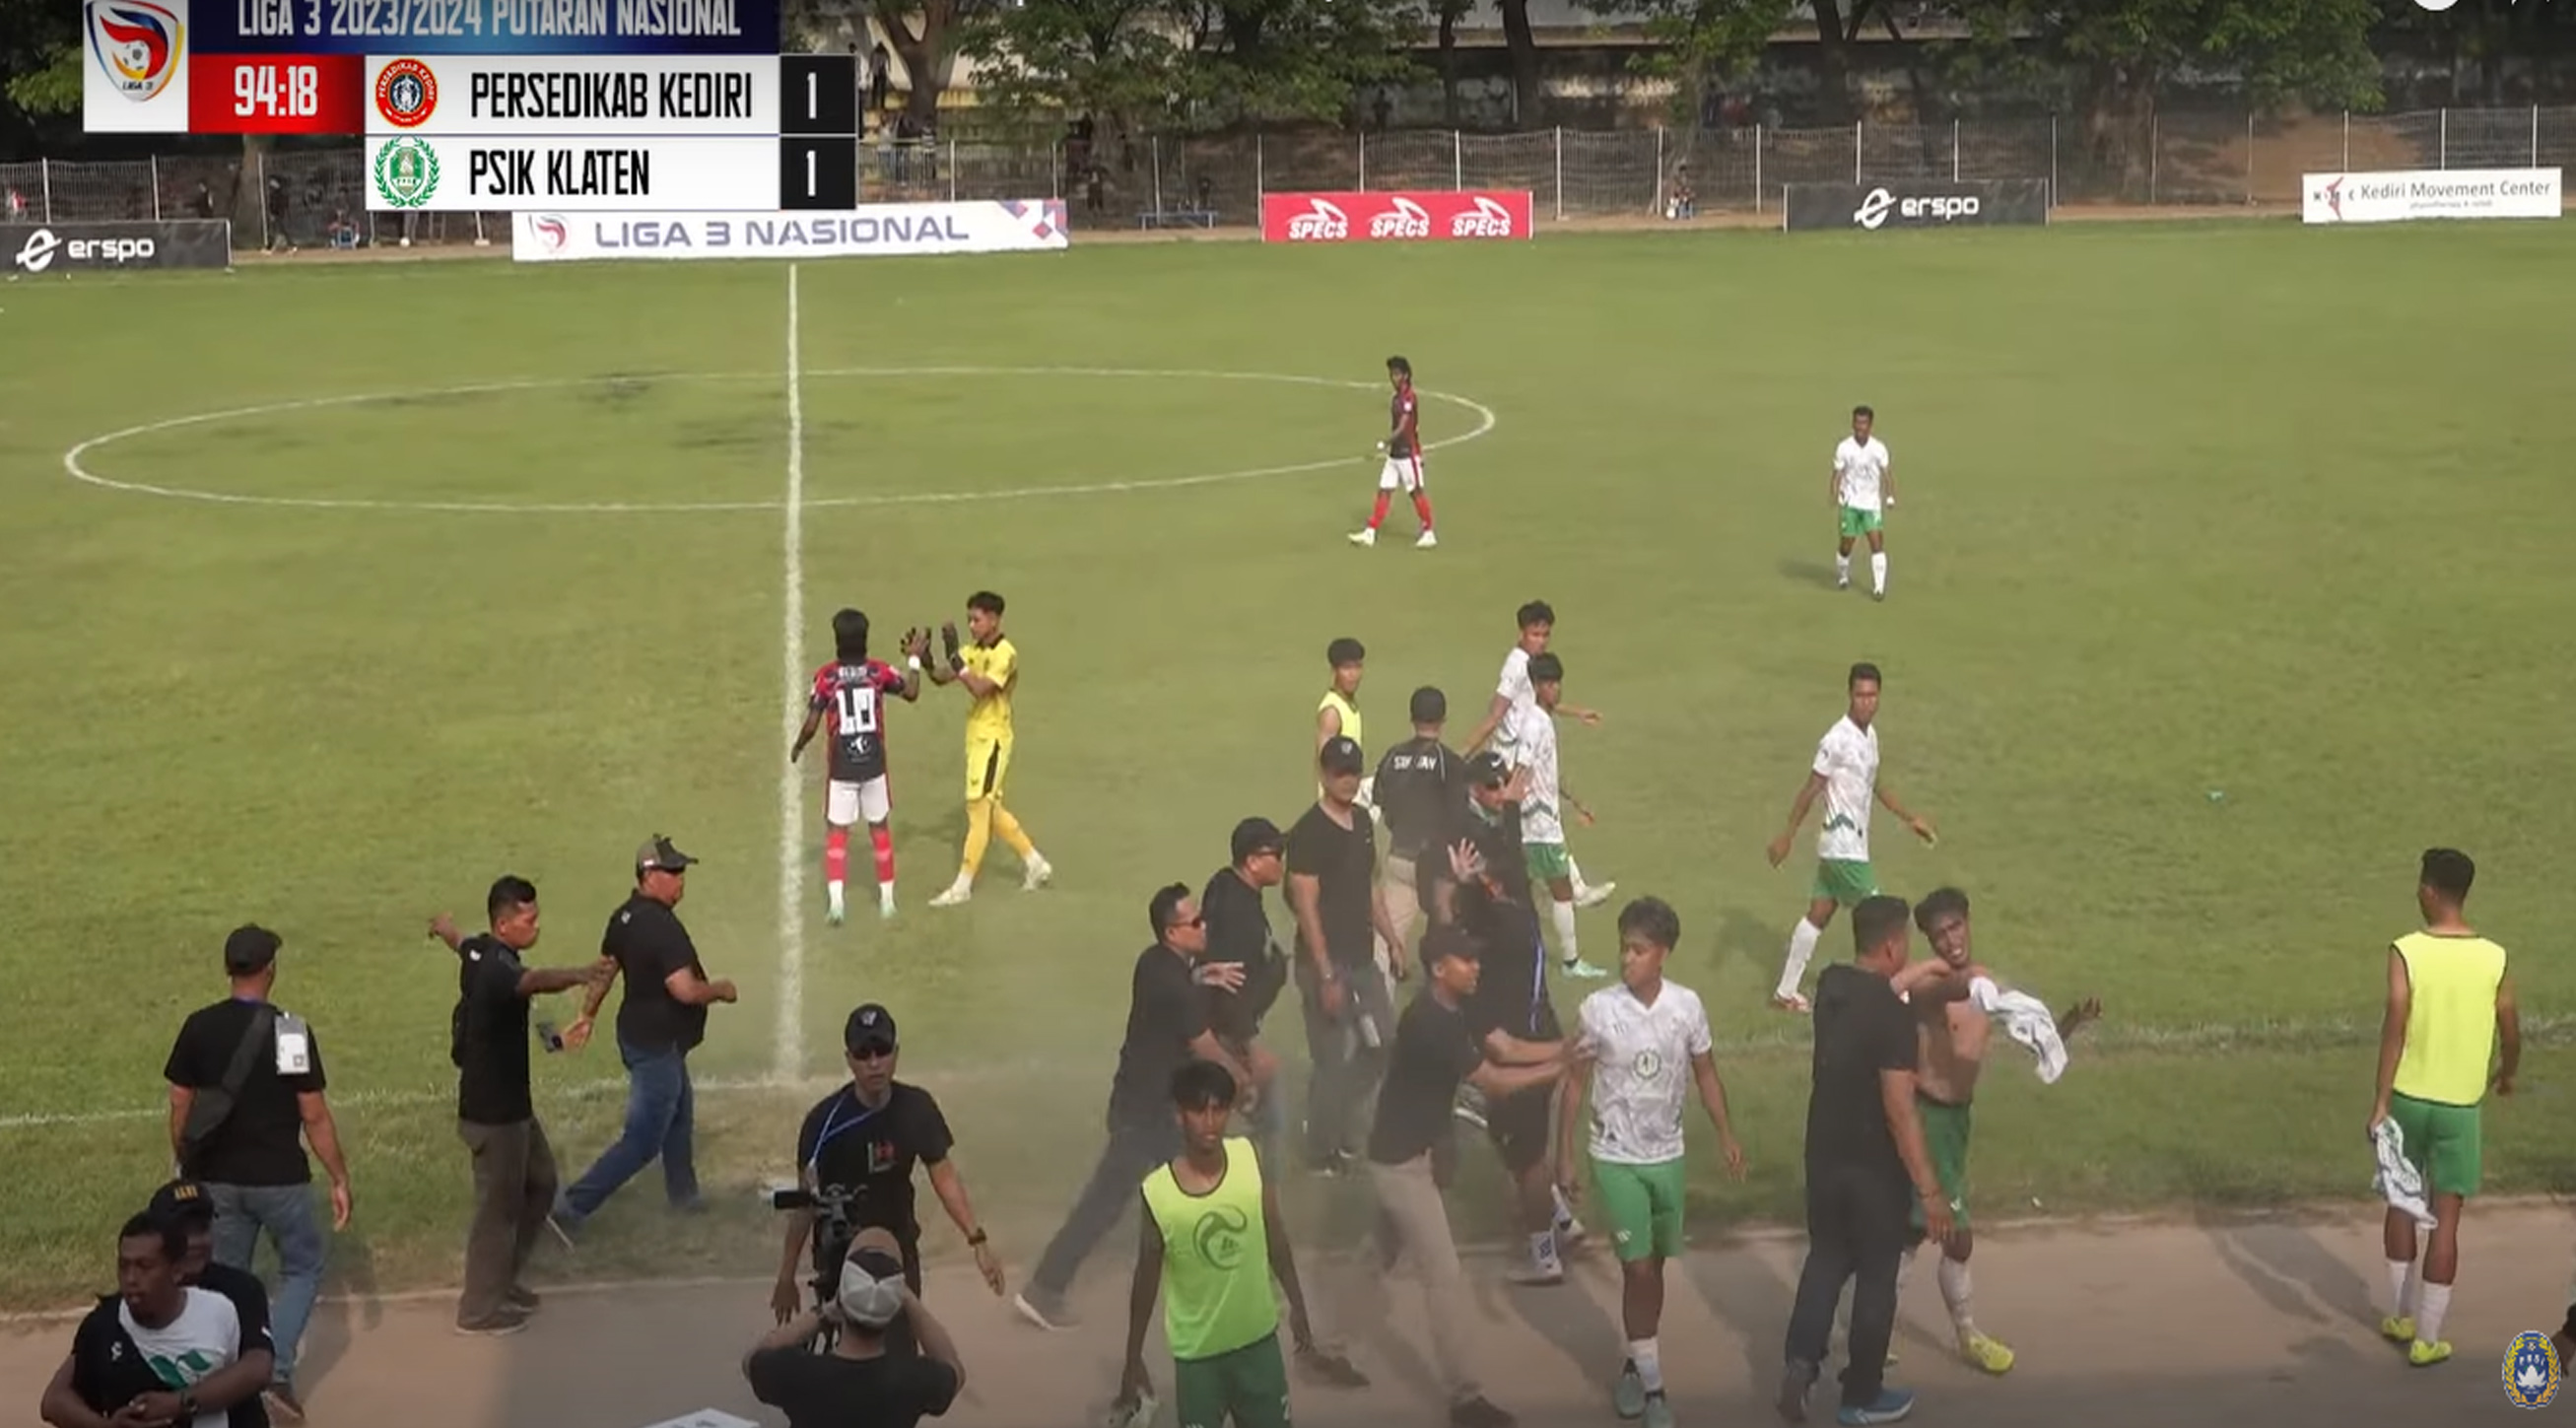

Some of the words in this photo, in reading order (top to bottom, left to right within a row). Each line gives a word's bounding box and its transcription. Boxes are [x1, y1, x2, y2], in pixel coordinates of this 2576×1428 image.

[2361, 182, 2406, 200] Kediri
[2410, 181, 2494, 198] Movement
[2499, 179, 2550, 196] Center
[1901, 196, 1980, 221] erspo
[594, 222, 692, 248] LIGA
[707, 221, 731, 246] 3
[745, 215, 971, 246] NASIONAL
[1289, 221, 1348, 239] SPECS
[1370, 220, 1429, 238] SPECS
[1452, 218, 1511, 237] SPECS
[68, 238, 155, 262] erspo
